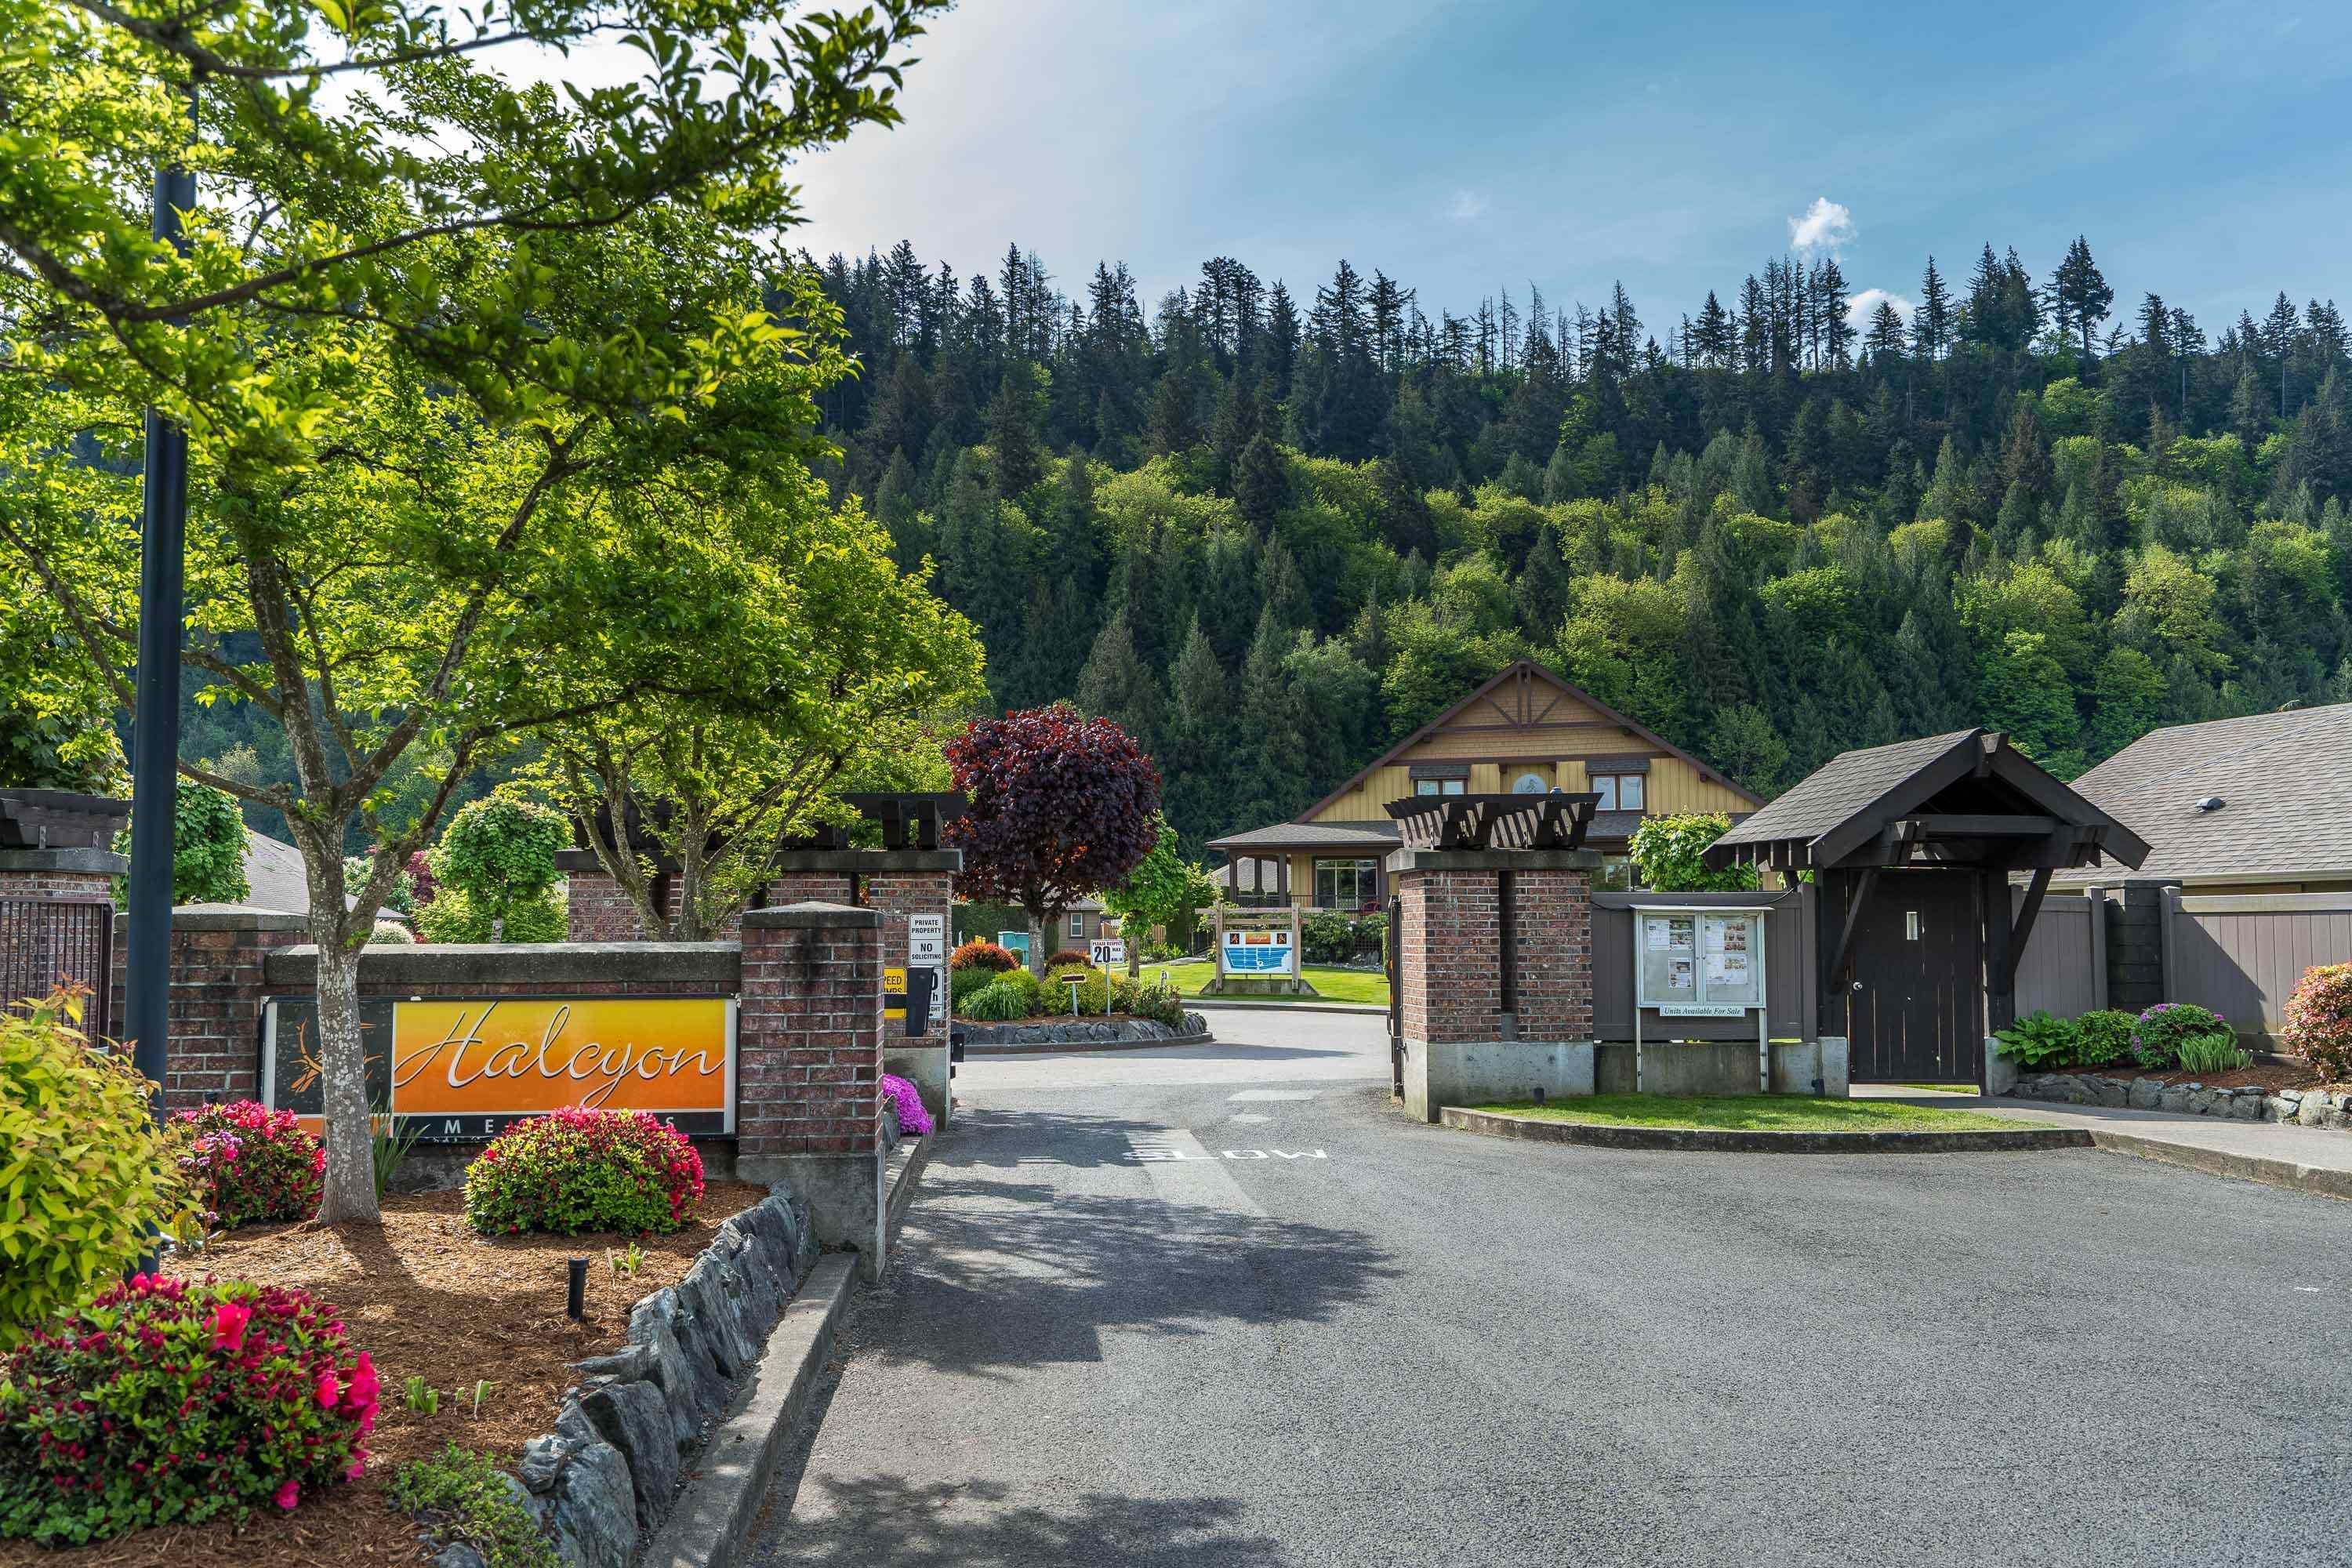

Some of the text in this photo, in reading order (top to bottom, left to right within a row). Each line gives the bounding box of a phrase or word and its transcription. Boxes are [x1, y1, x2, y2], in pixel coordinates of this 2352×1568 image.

[920, 943, 933, 952] NO
[1094, 946, 1110, 963] 20
[394, 1001, 726, 1110] Halcyon
[1122, 1149, 1328, 1160] SLOW
